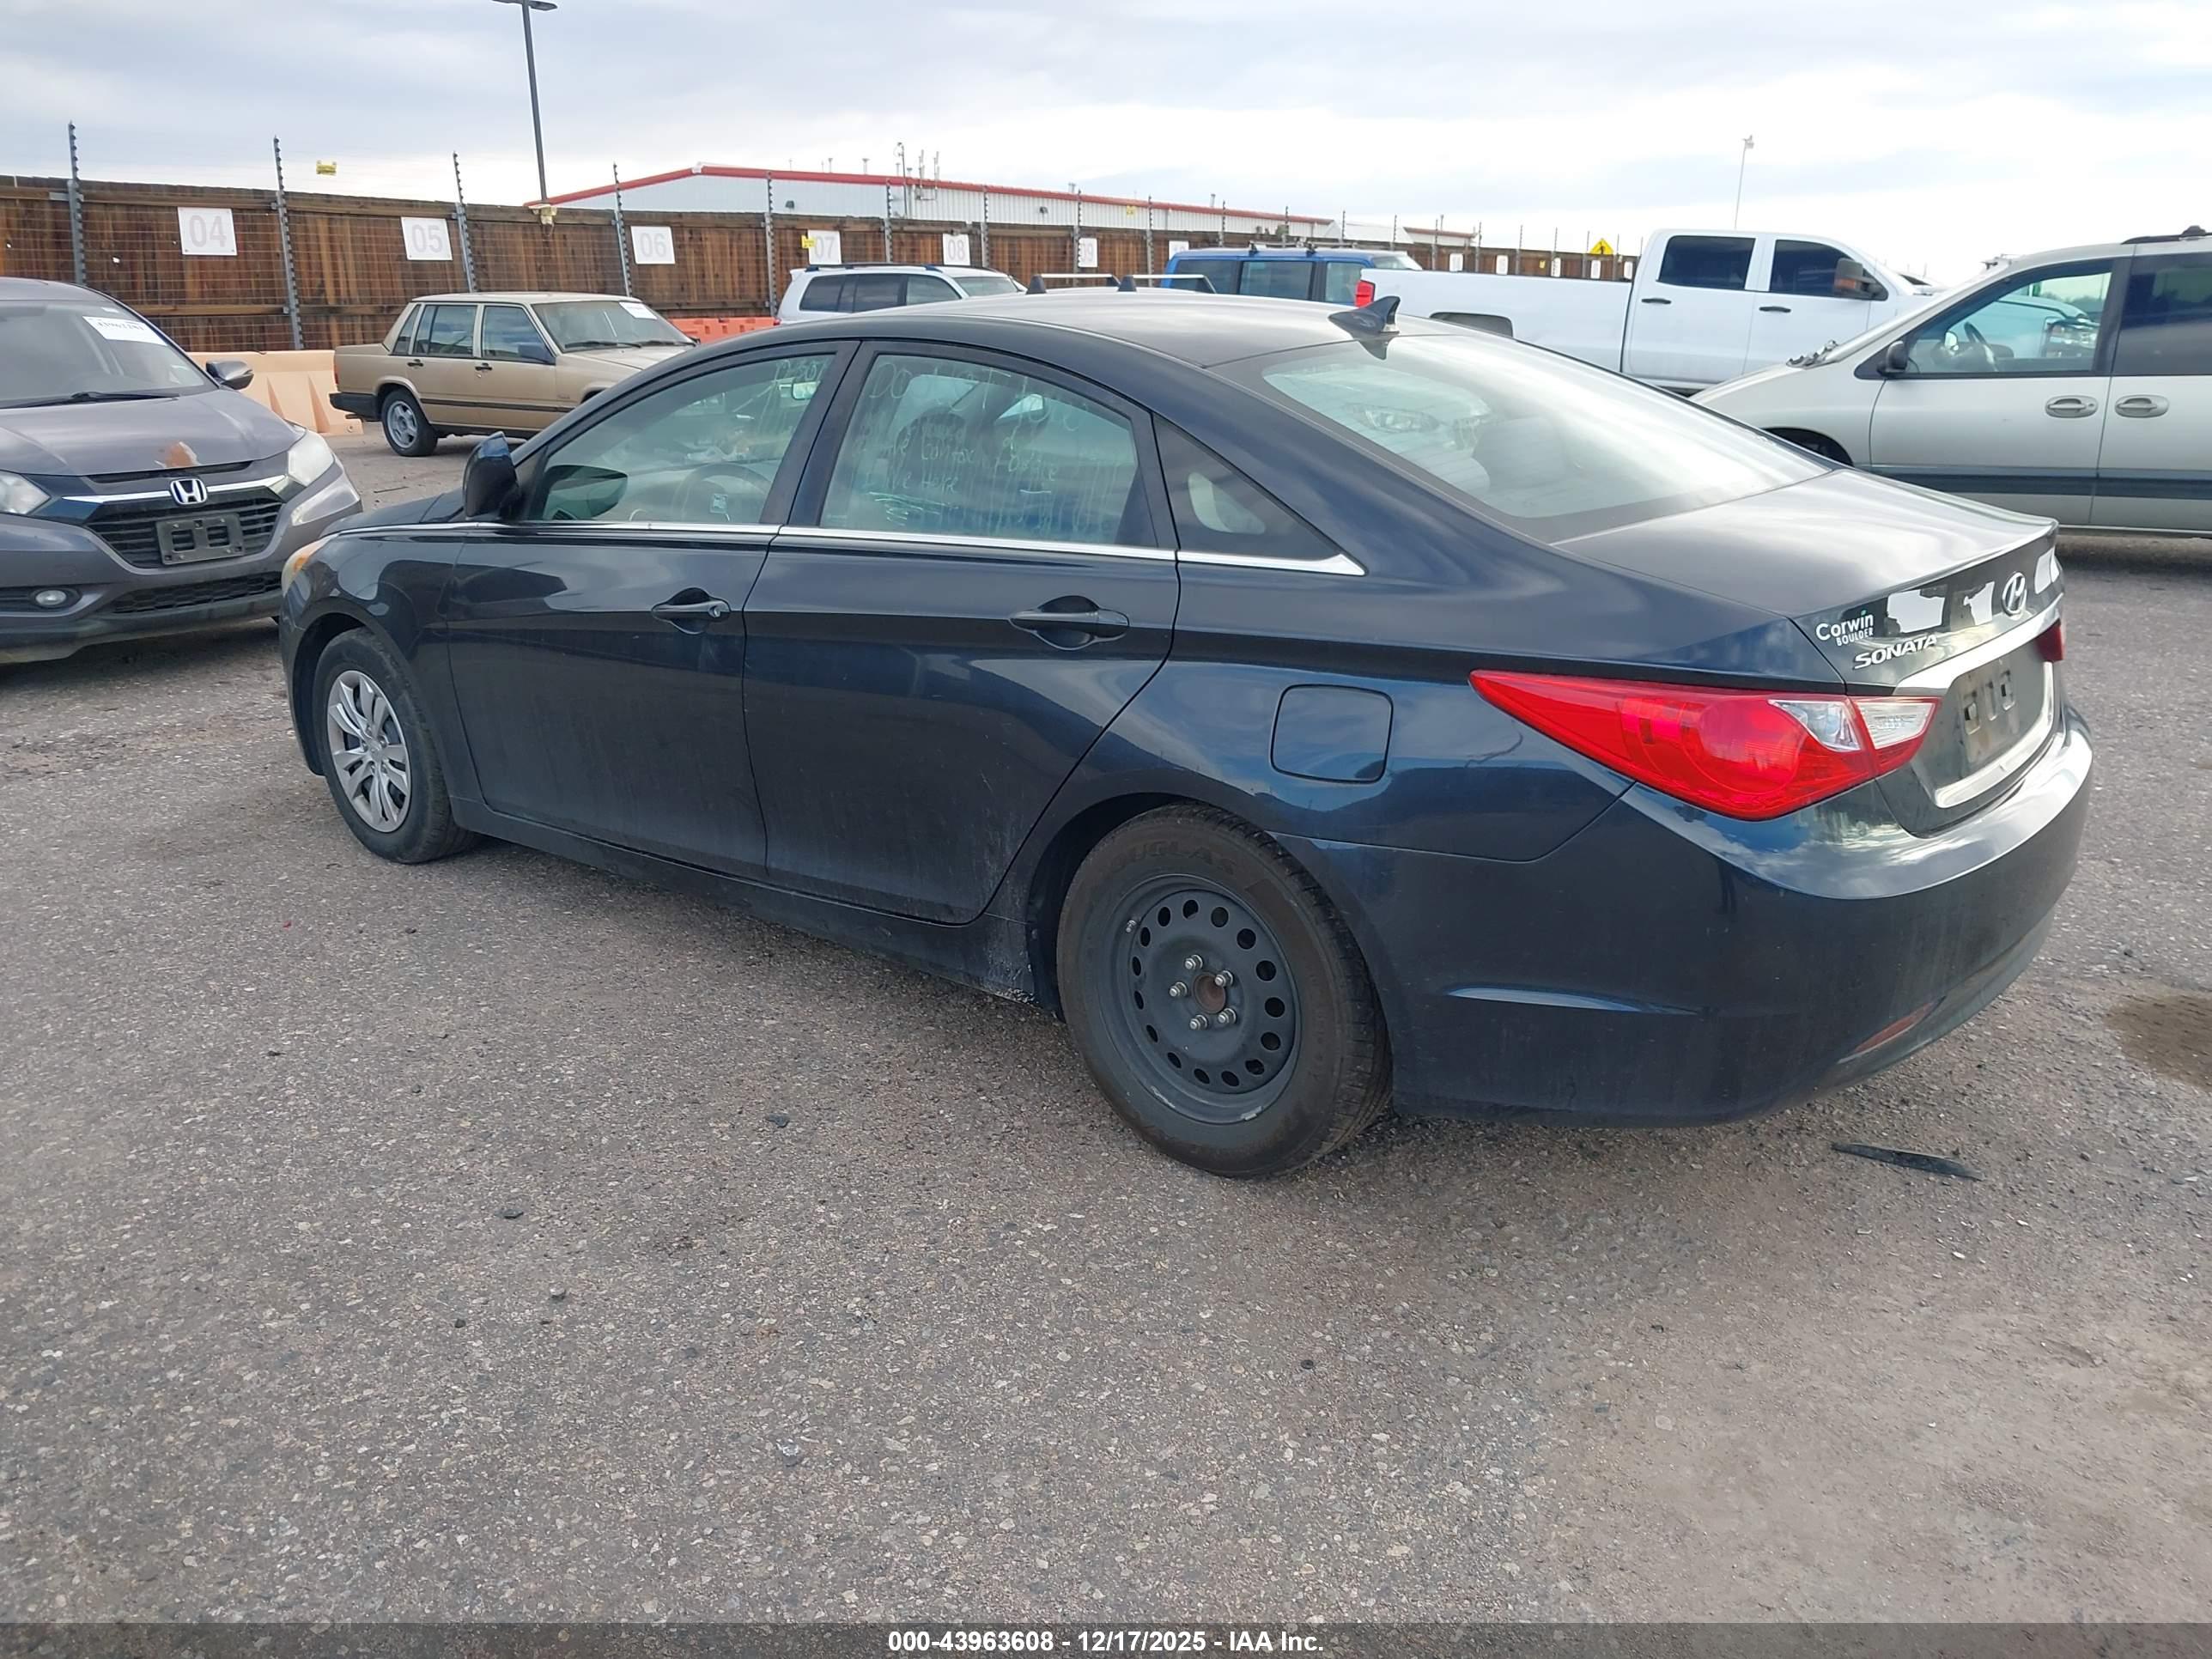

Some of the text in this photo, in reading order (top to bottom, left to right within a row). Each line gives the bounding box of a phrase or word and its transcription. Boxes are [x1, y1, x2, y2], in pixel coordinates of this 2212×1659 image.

[189, 214, 227, 248] 04
[411, 223, 444, 253] 05
[640, 232, 666, 258] 06
[814, 234, 836, 260] 07
[947, 240, 965, 261] 08
[1815, 609, 1874, 641] Corwin
[1835, 627, 1875, 647] BOULDER
[1853, 634, 1938, 670] SONATA
